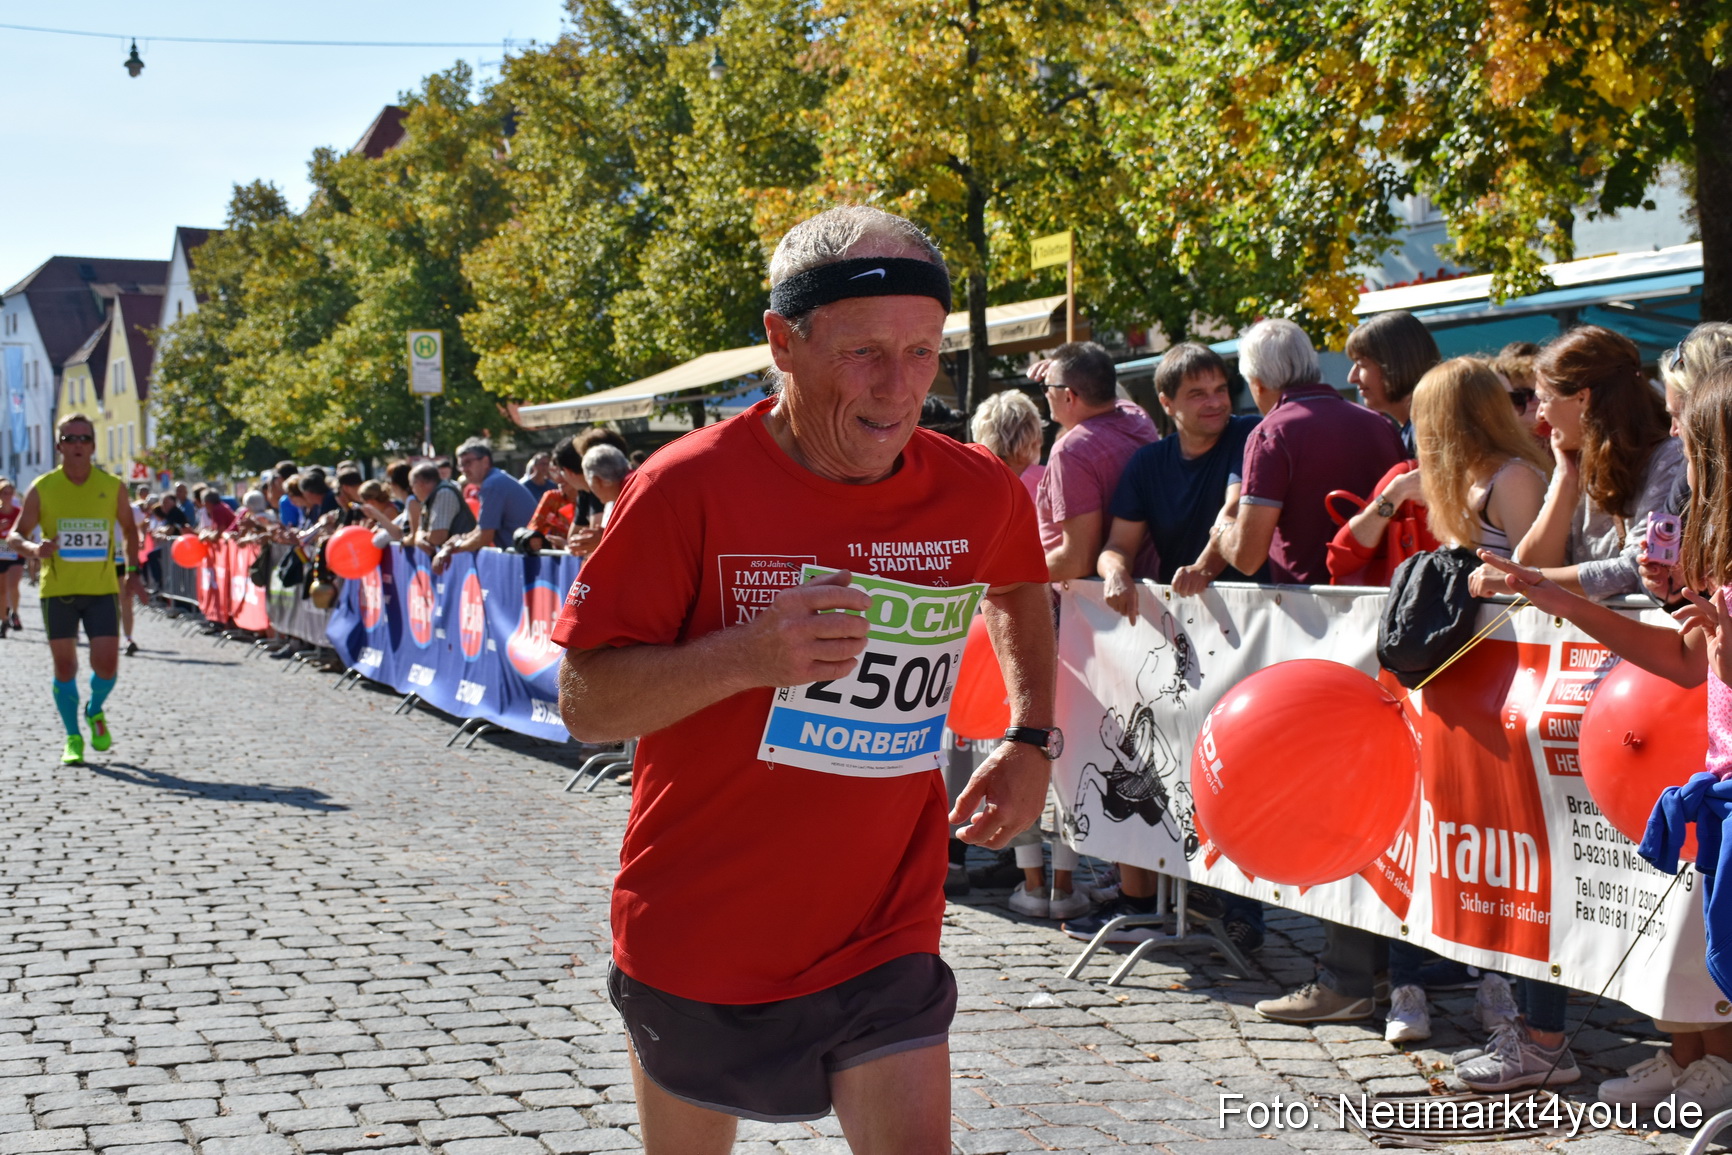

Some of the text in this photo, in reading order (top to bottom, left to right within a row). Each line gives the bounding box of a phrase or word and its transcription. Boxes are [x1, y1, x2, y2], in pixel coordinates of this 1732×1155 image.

[64, 533, 102, 547] 2812
[847, 539, 969, 557] 11. NEUMARKTER
[750, 560, 767, 568] 850
[869, 556, 952, 572] STADTLAUF
[735, 570, 801, 586] IMMER
[852, 588, 970, 639] OCK
[777, 686, 789, 702] ZE
[799, 720, 932, 755] NORBERT
[1555, 753, 1581, 773] HE
[1566, 795, 1602, 817] Brau
[1572, 819, 1591, 840] Am
[1421, 798, 1539, 894] Braun
[1573, 842, 1619, 868] D-92318
[1575, 876, 1595, 898] Tel.
[1598, 881, 1629, 906] 09181
[1460, 891, 1551, 925] Sicher ist sicher
[1575, 900, 1595, 922] Fax
[1599, 905, 1628, 930] 09181
